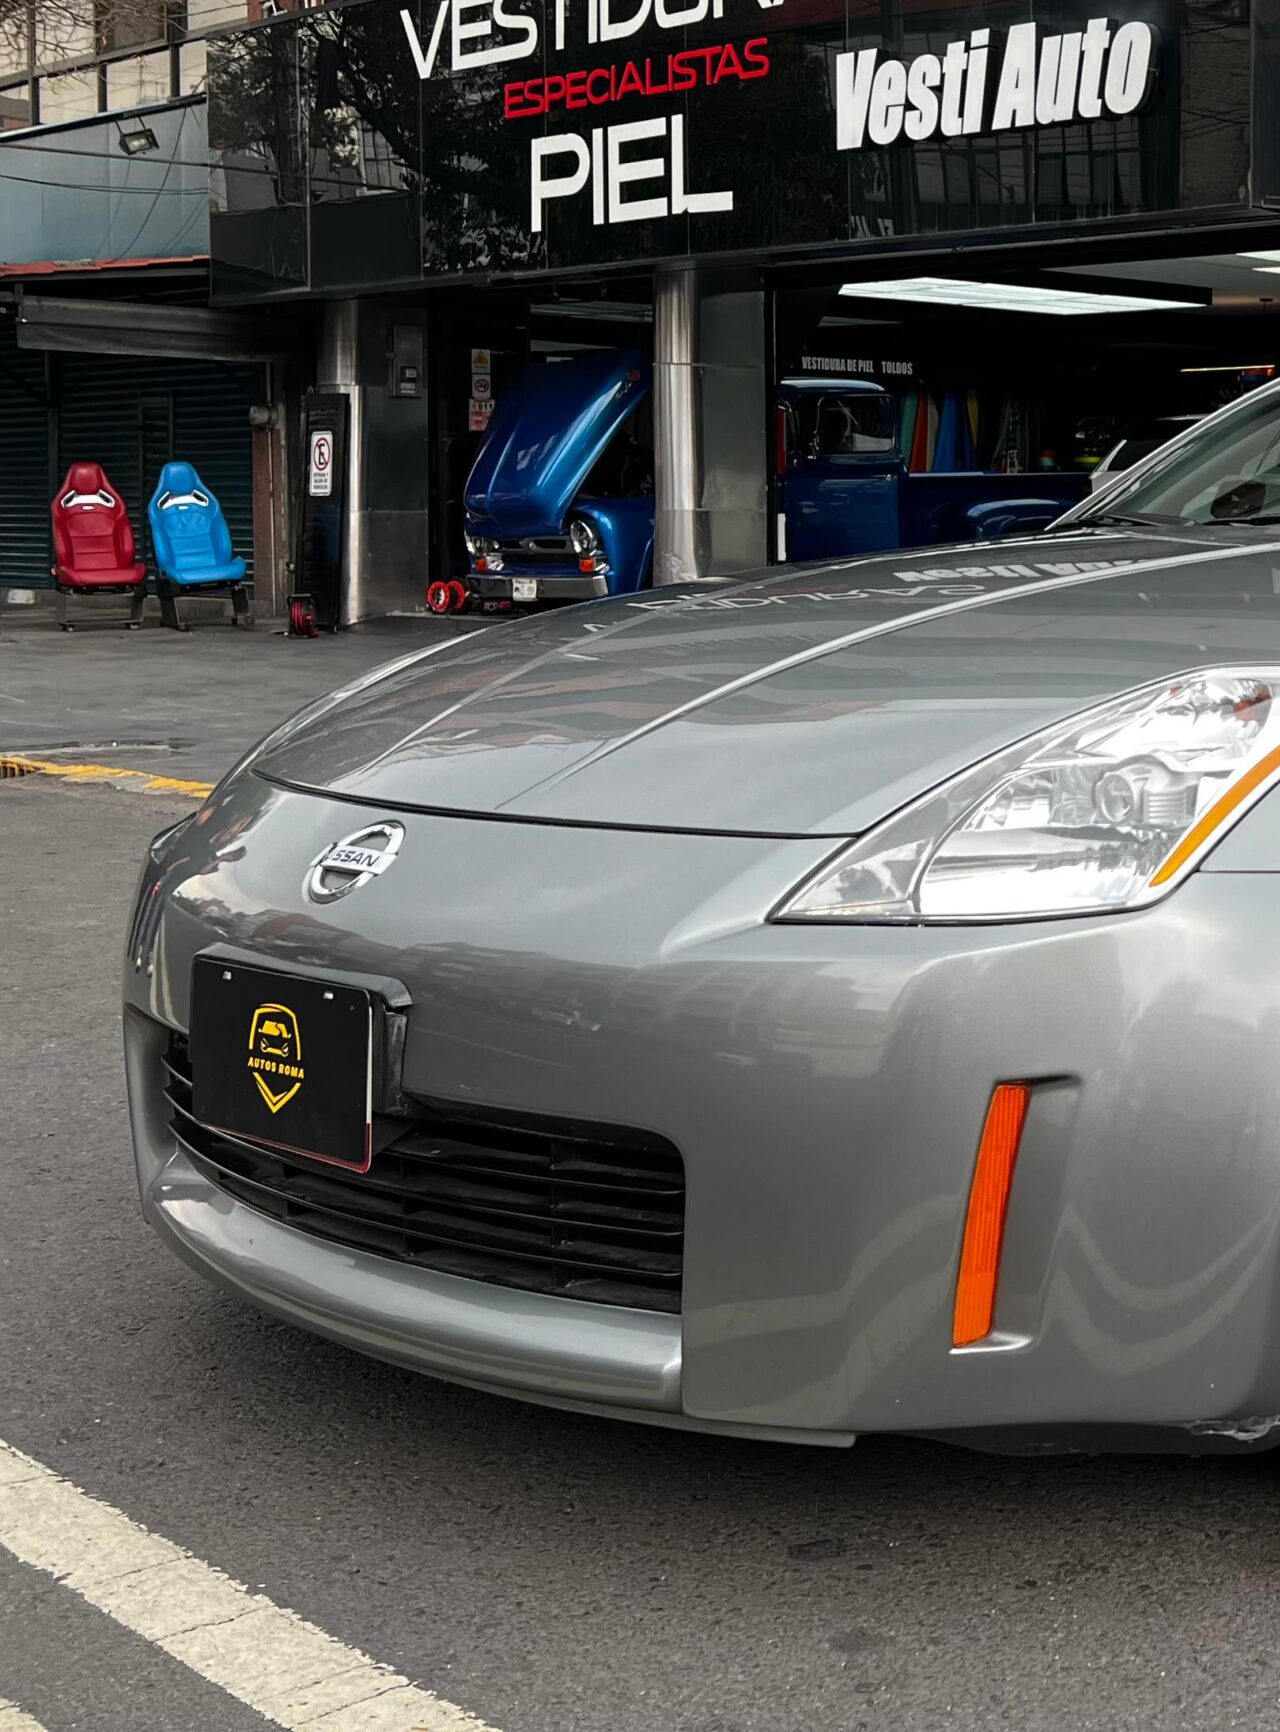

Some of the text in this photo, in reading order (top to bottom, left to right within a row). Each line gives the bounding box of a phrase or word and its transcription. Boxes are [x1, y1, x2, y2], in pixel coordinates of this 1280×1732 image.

[400, 0, 785, 80] VESTID
[504, 37, 770, 118] ESPECIALISTAS
[836, 17, 1152, 151] Vesti Auto
[531, 114, 733, 233] PIEL
[802, 356, 913, 375] VESTIDURA DE PIEL TOLDOS
[247, 1056, 305, 1079] AUTOS ROMA
